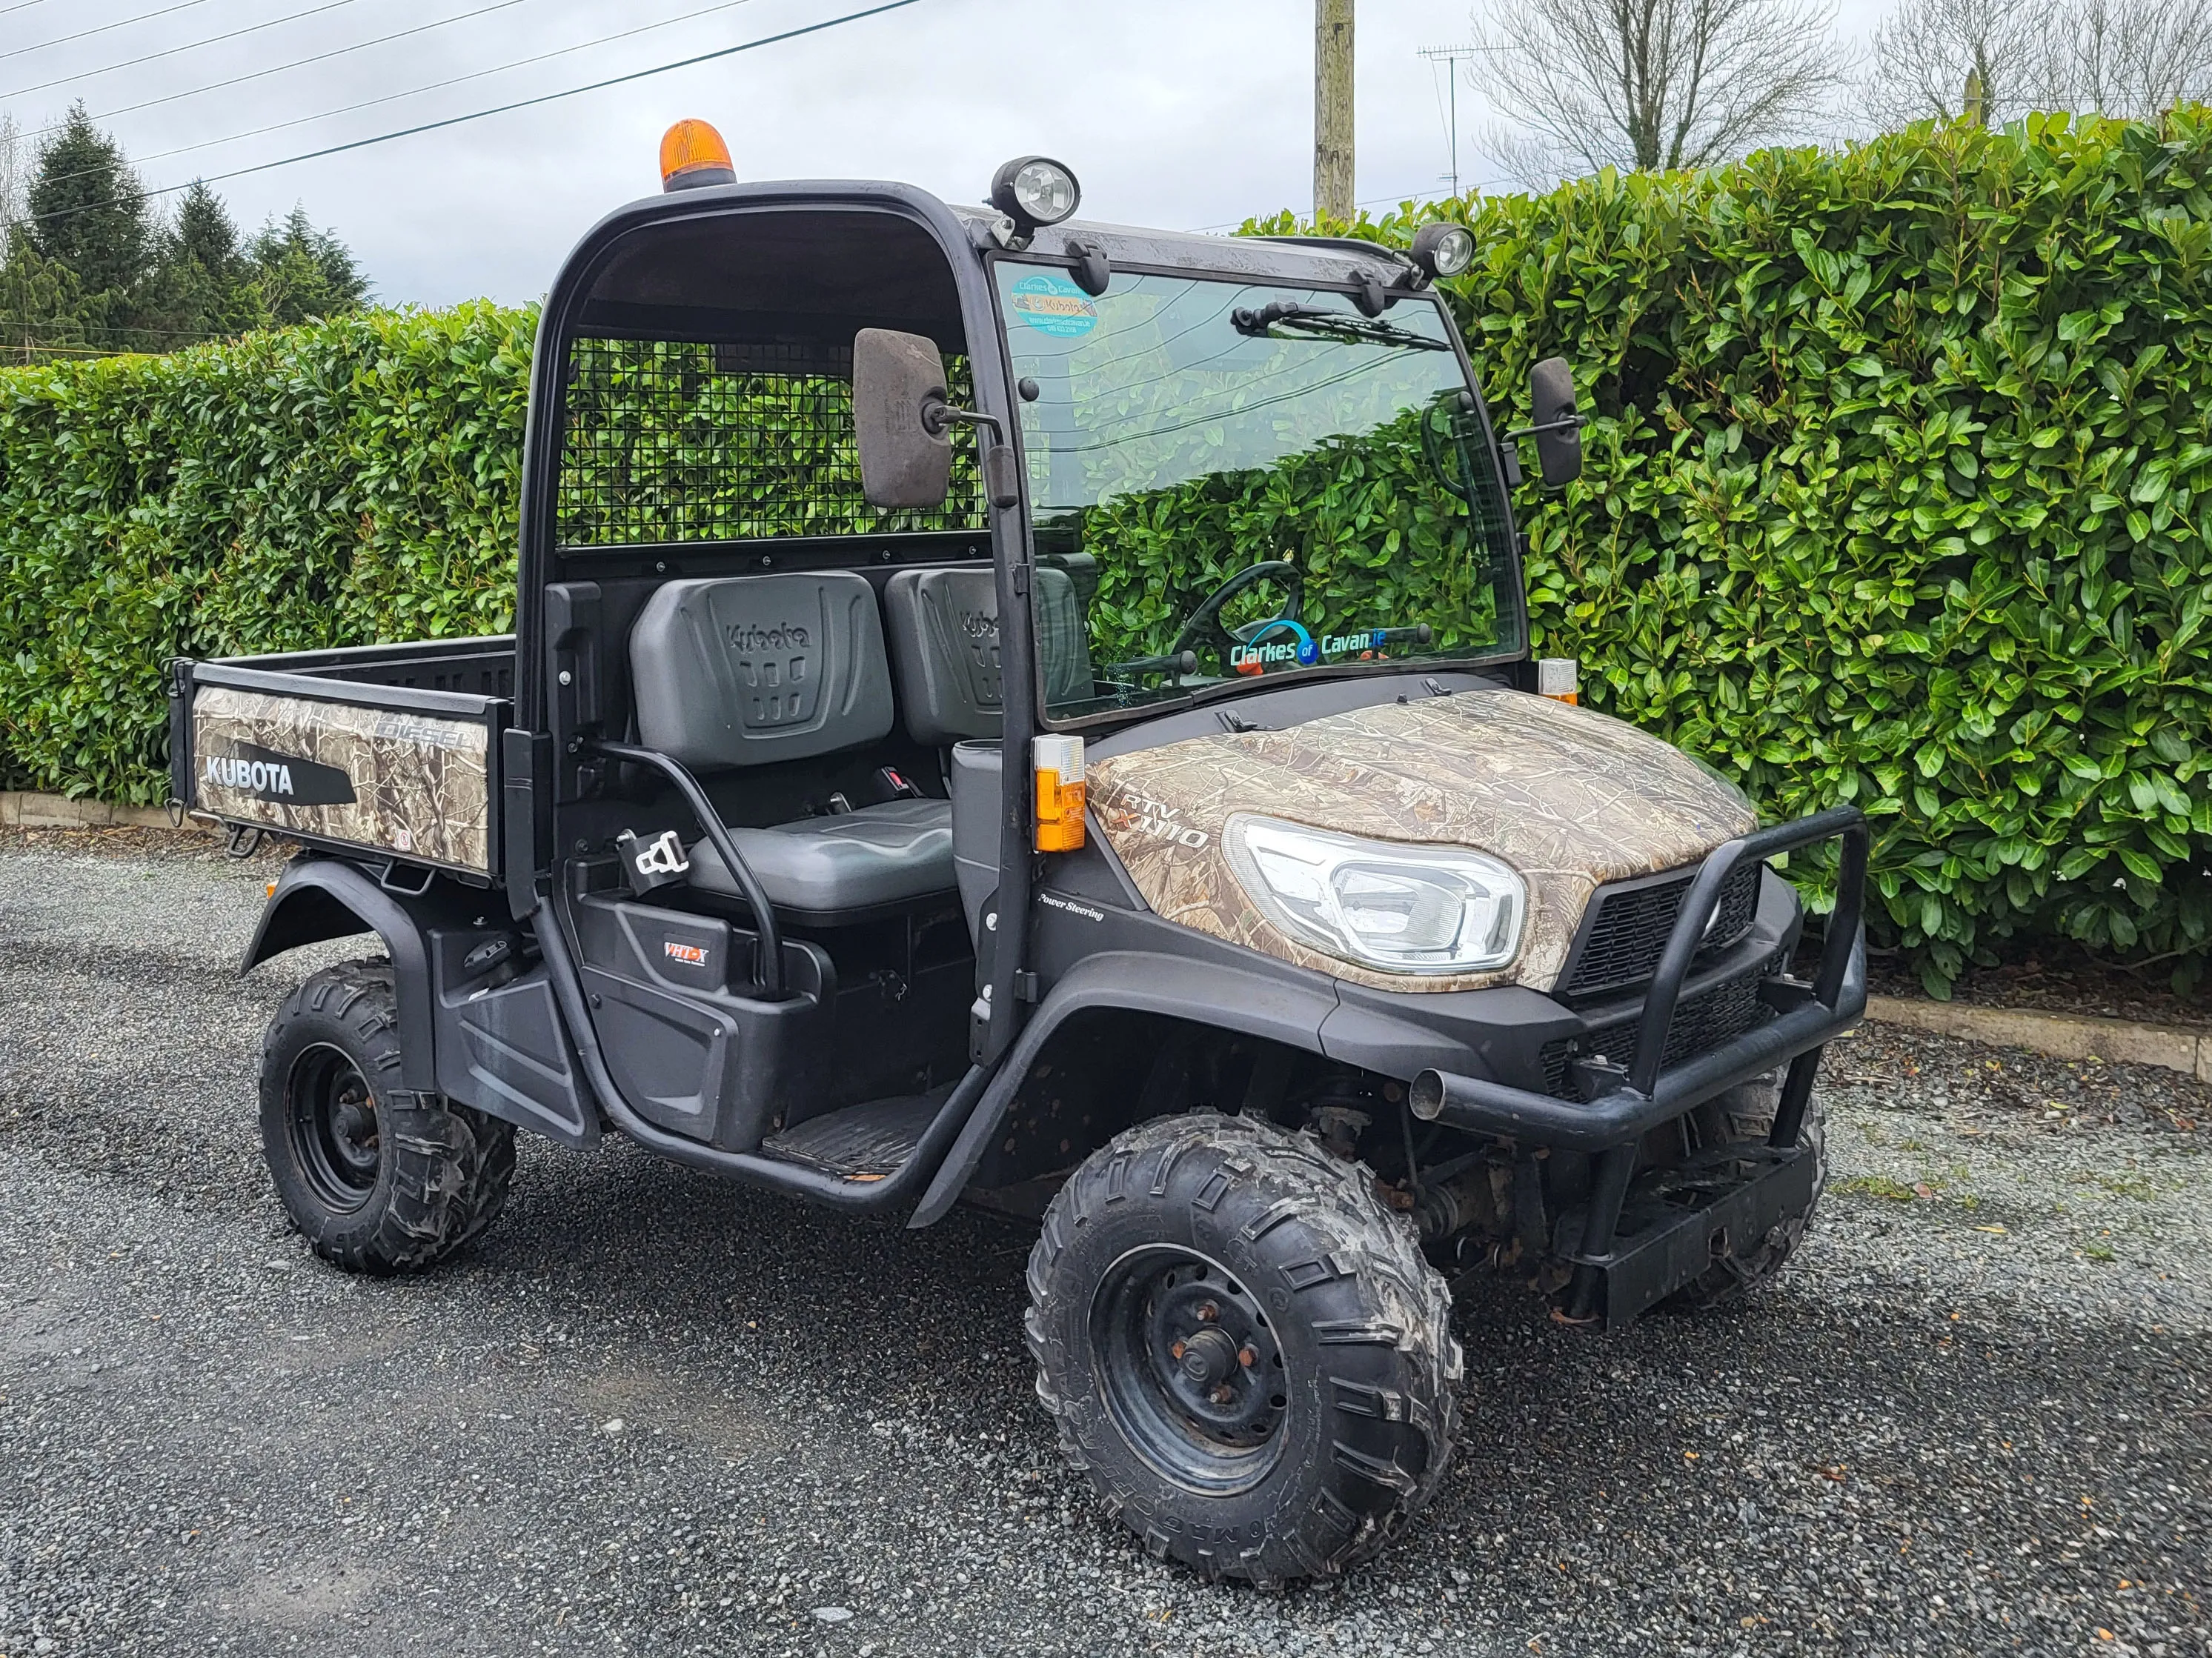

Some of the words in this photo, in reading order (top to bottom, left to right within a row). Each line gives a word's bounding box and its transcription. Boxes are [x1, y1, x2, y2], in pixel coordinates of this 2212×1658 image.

[1019, 282, 1047, 292] Clarkes
[1058, 285, 1081, 295] Cavan
[1046, 299, 1080, 312] Kubota
[725, 621, 811, 653] Kubota
[1230, 642, 1296, 666] Clarkes
[1301, 644, 1314, 656] of
[375, 722, 475, 748] DIESEL
[206, 755, 294, 796] KUBOTA
[1120, 793, 1180, 819] RTV
[1112, 808, 1209, 848] X1110
[1037, 893, 1066, 908] Power
[1066, 902, 1104, 922] Steering
[1162, 1515, 1240, 1545] MAG
